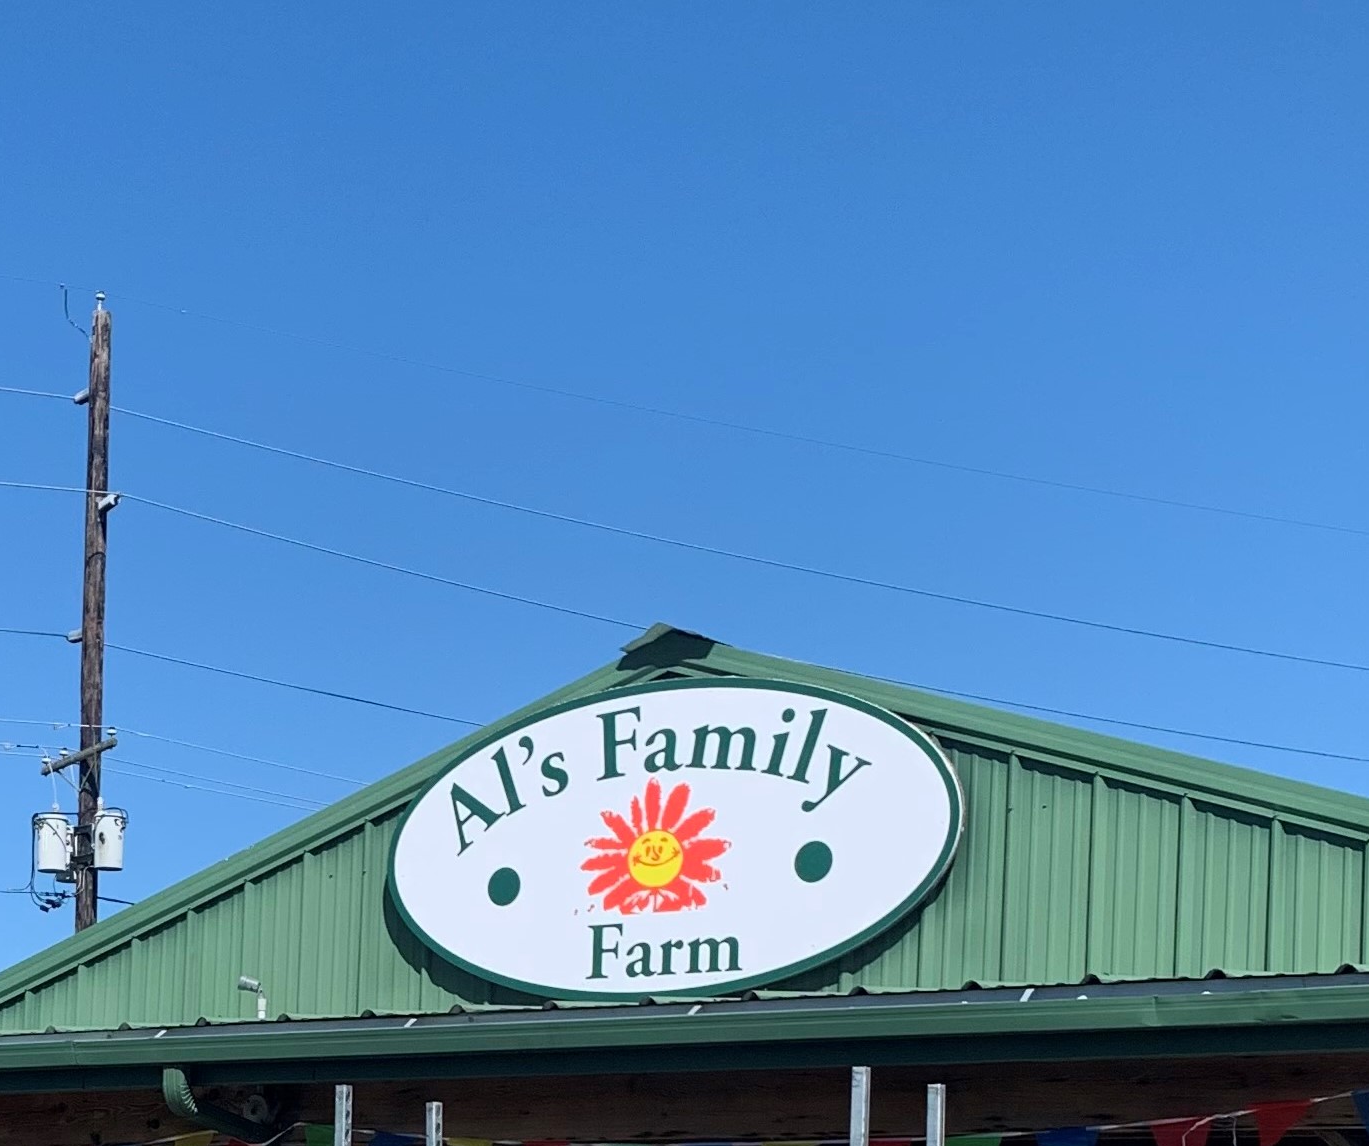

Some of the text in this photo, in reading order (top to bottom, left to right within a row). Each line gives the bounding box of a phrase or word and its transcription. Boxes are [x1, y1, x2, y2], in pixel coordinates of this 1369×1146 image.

[450, 706, 871, 855] Al's Family
[586, 923, 742, 979] Farm
